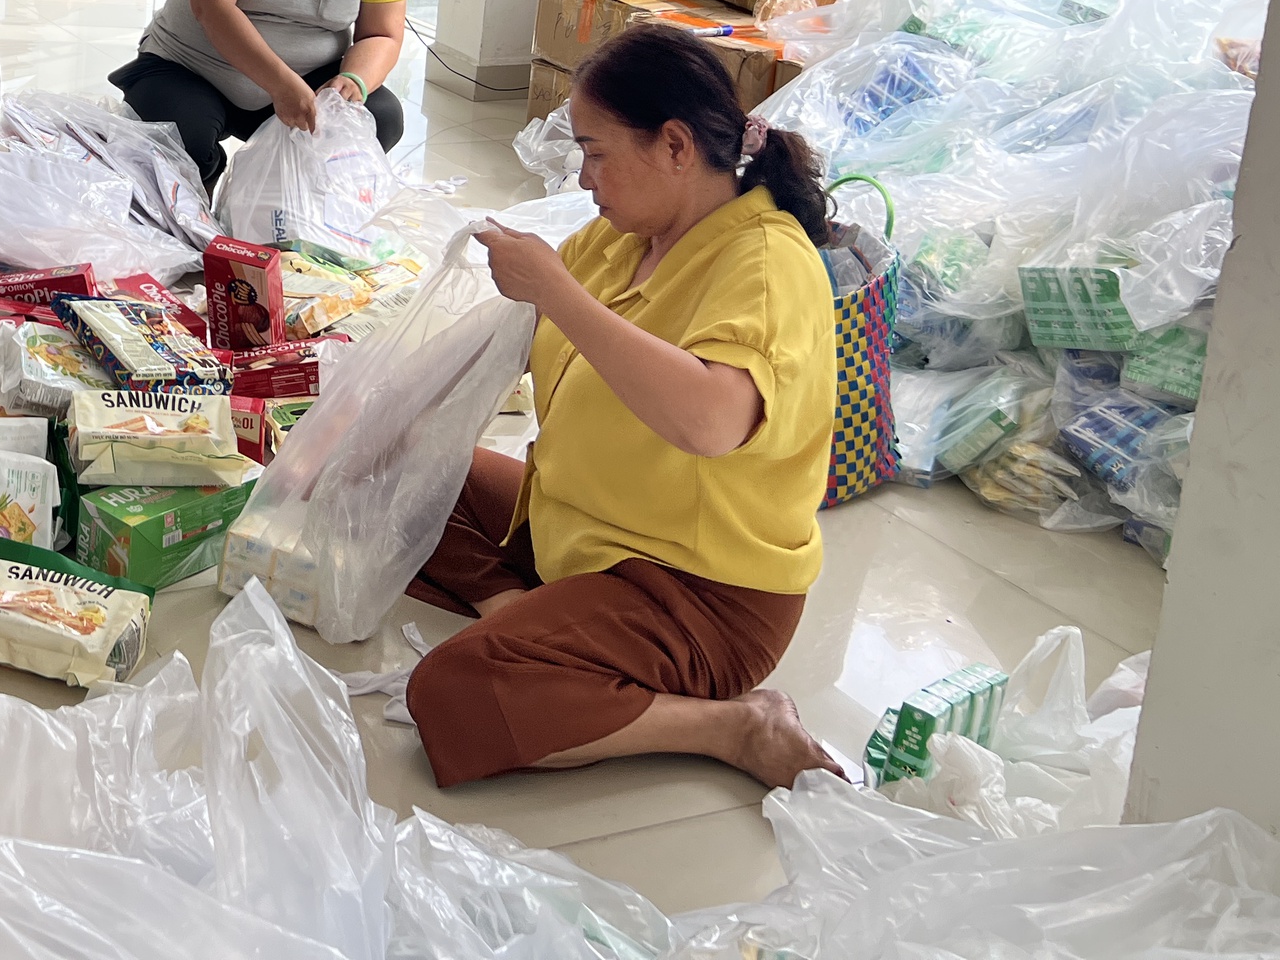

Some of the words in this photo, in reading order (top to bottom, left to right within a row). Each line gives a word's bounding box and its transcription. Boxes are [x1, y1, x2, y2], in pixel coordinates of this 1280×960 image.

[216, 243, 255, 258] ChocoPie
[7, 283, 35, 292] ORION
[212, 282, 231, 350] ChocoPie
[101, 392, 202, 414] SANDWICH
[242, 418, 254, 429] 10
[100, 485, 158, 507] HURA
[77, 522, 91, 567] HURA
[7, 565, 116, 600] SANDWICH
